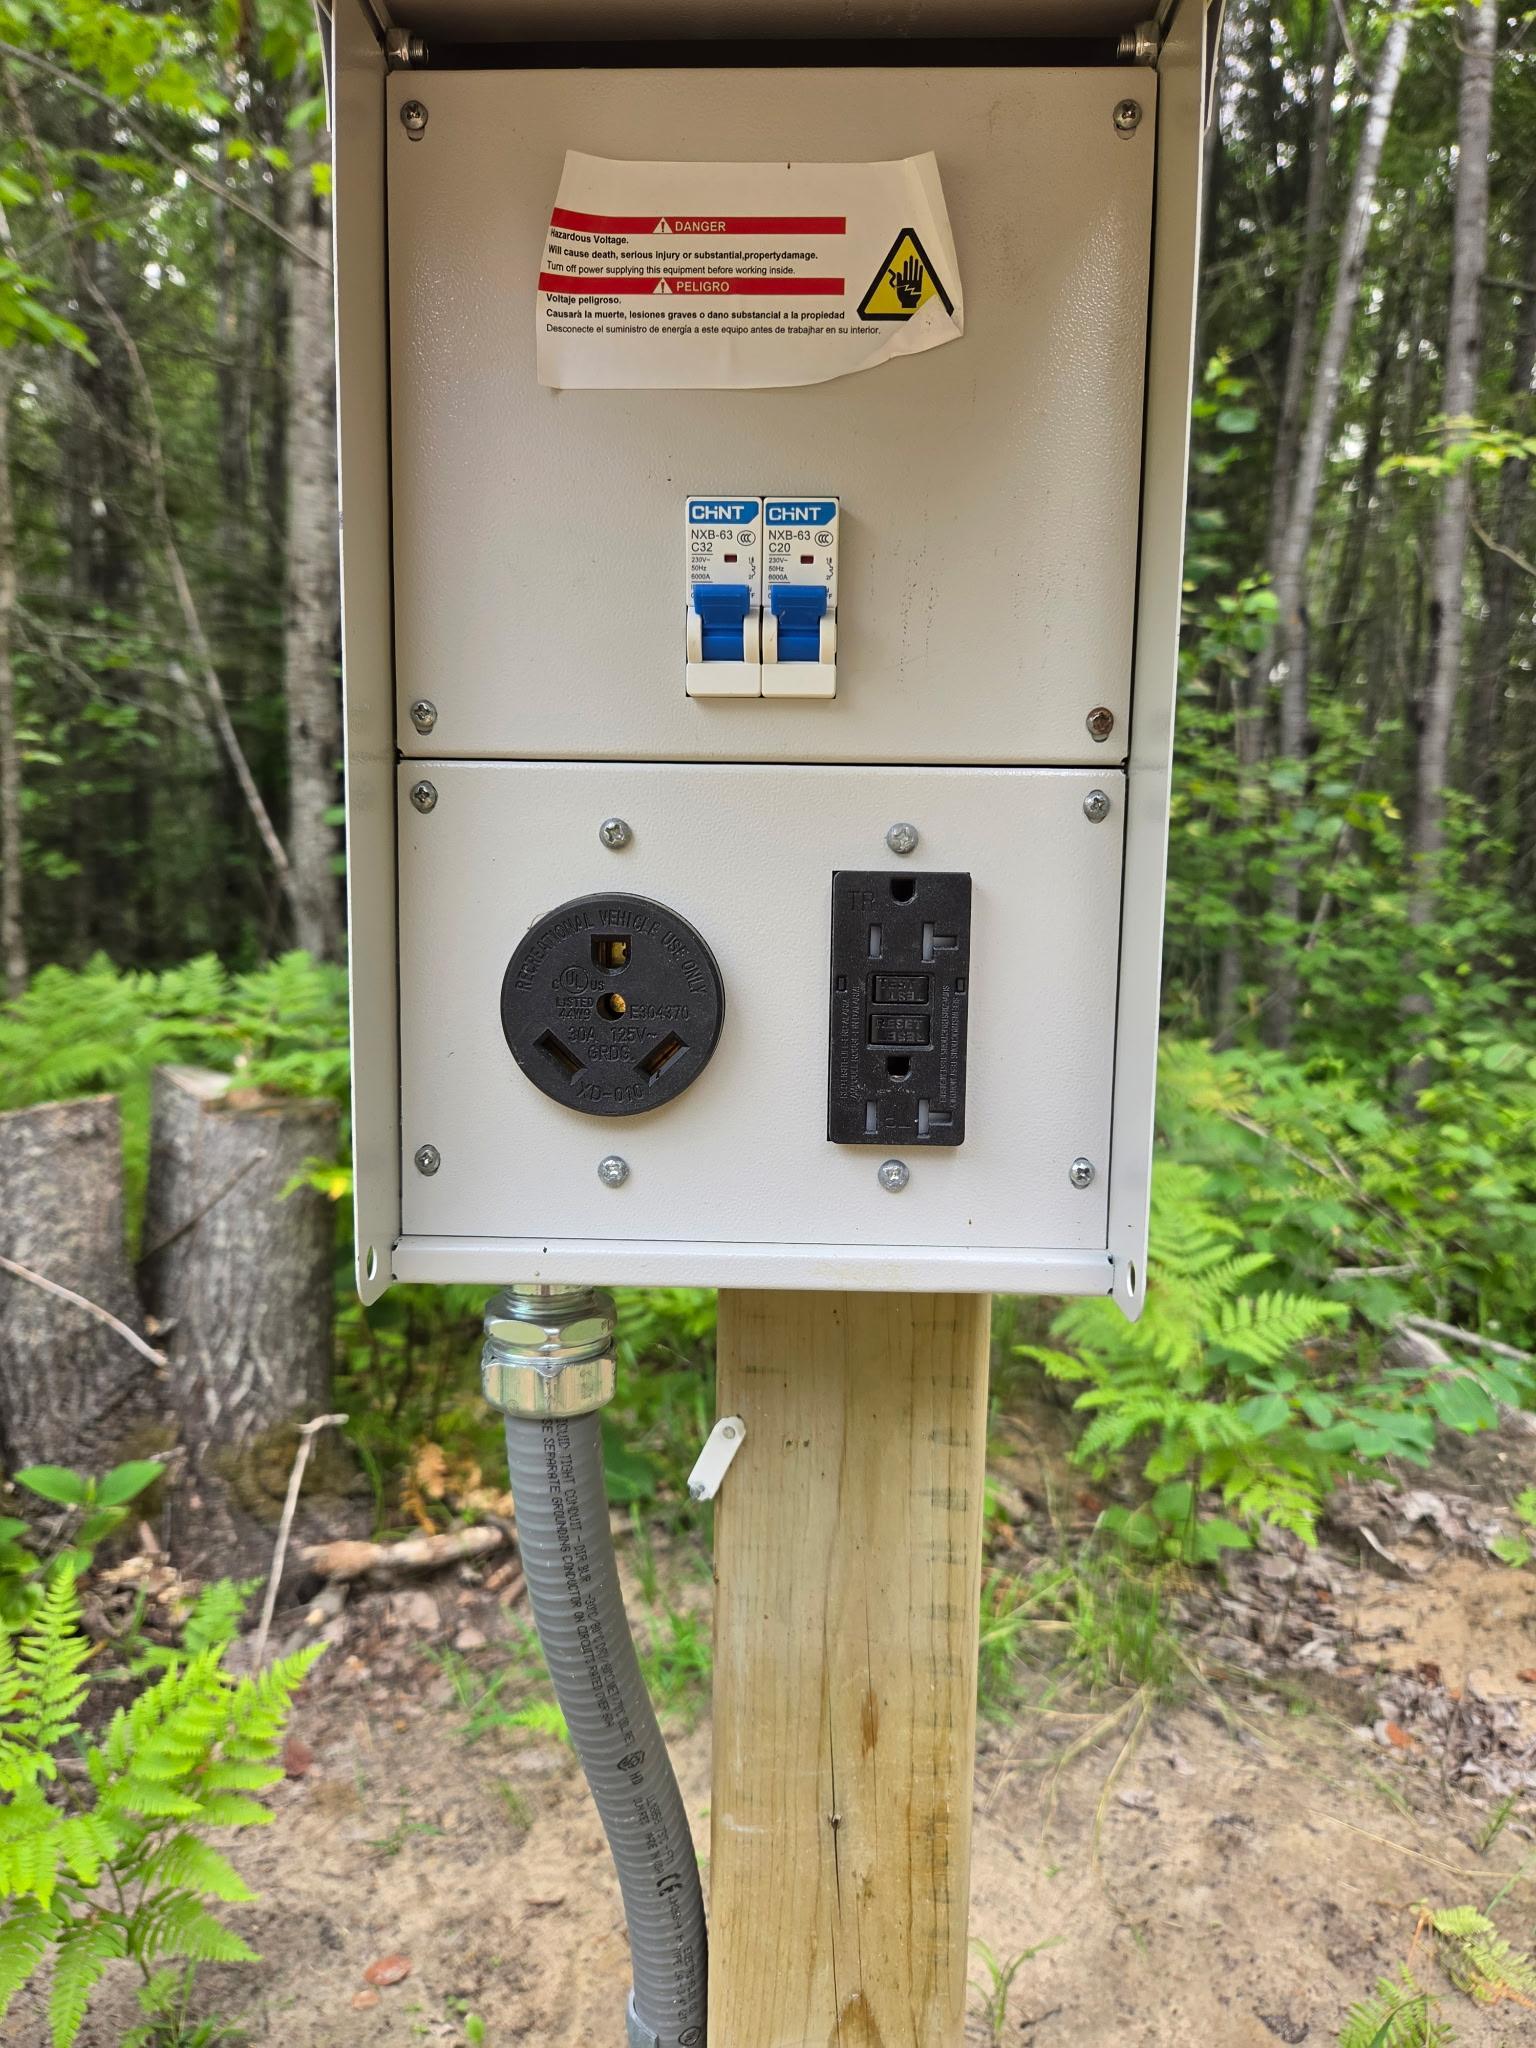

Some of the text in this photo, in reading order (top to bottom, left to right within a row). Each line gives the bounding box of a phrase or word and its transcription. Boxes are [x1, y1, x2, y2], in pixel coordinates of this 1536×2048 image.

[675, 222, 726, 231] DANGER
[551, 228, 628, 245] Hazardous Voltage.
[549, 244, 562, 255] Will
[564, 249, 589, 258] cause
[592, 251, 618, 260] death,
[621, 251, 653, 259] serious
[547, 261, 795, 275] Turn off power supplying this equipment before working inside.
[677, 281, 729, 292] PELIGRO
[547, 294, 621, 305] Voltaje peligroso.
[585, 309, 592, 318] la
[595, 311, 627, 319] muerte,
[630, 311, 665, 319] lesiones
[668, 312, 697, 320] graves
[732, 311, 780, 319] substancial
[791, 311, 799, 319] la
[801, 311, 844, 321] propiedad
[547, 324, 594, 333] Desconecte
[596, 325, 604, 333] el
[606, 325, 647, 333] suministro
[649, 325, 659, 333] de
[721, 325, 748, 336] equipo
[750, 326, 772, 334] antes
[775, 326, 785, 334] de
[788, 326, 823, 335] trabajhar
[851, 326, 880, 334] interior.
[691, 530, 733, 540] NXB-63
[769, 531, 810, 540] NXB-63
[691, 543, 713, 552] C32
[769, 543, 791, 553] C20
[515, 909, 708, 994] RECREATIONAL VEHICLE USE ONLY
[556, 997, 594, 1008] LISTED
[543, 1437, 561, 1493] SEPARATE
[559, 1453, 576, 1484] TIGHT
[564, 1488, 582, 1531] CONDUIT
[551, 1496, 571, 1553] GROUNDING
[562, 1554, 582, 1608] CONDUCTOR
[574, 1611, 584, 1623] ON
